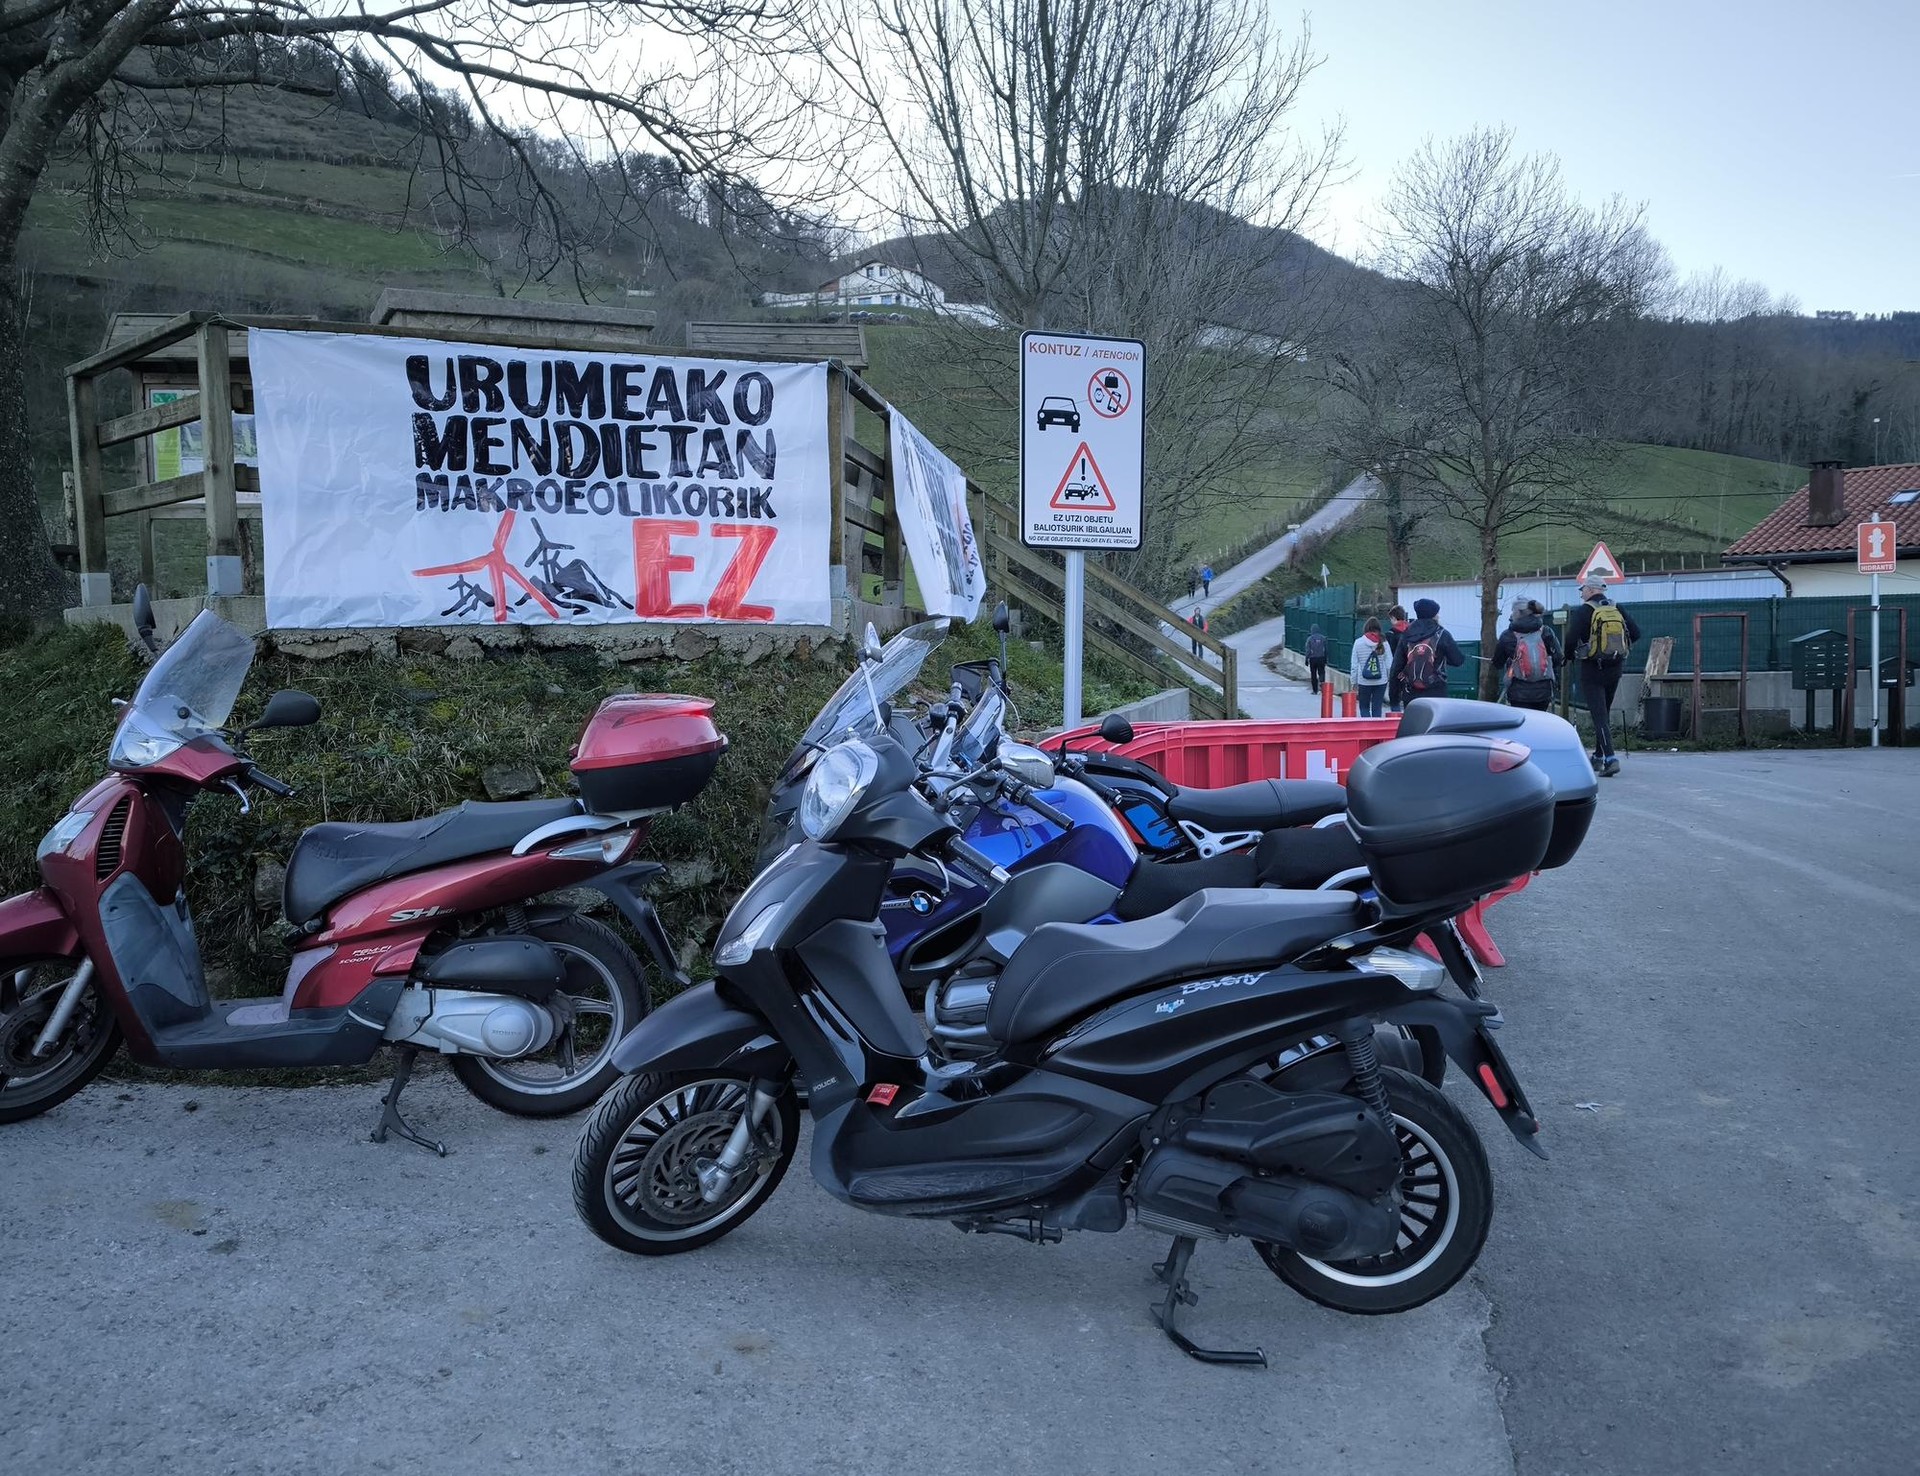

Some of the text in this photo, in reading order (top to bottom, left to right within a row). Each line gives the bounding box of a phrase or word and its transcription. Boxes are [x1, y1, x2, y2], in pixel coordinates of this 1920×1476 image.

[1029, 342, 1082, 357] KONTUZ
[405, 355, 775, 426] URUMEAKO
[412, 412, 777, 480] MENDIETAN
[415, 472, 778, 519] MAKROEOLIKORIK
[1053, 514, 1114, 523] EZ UTZI OBJETU
[1033, 523, 1132, 534] BALIOTSURIK IBILGAILUAN
[631, 517, 778, 621] EZ
[387, 906, 439, 922] SH
[813, 1076, 837, 1092] POLICE
